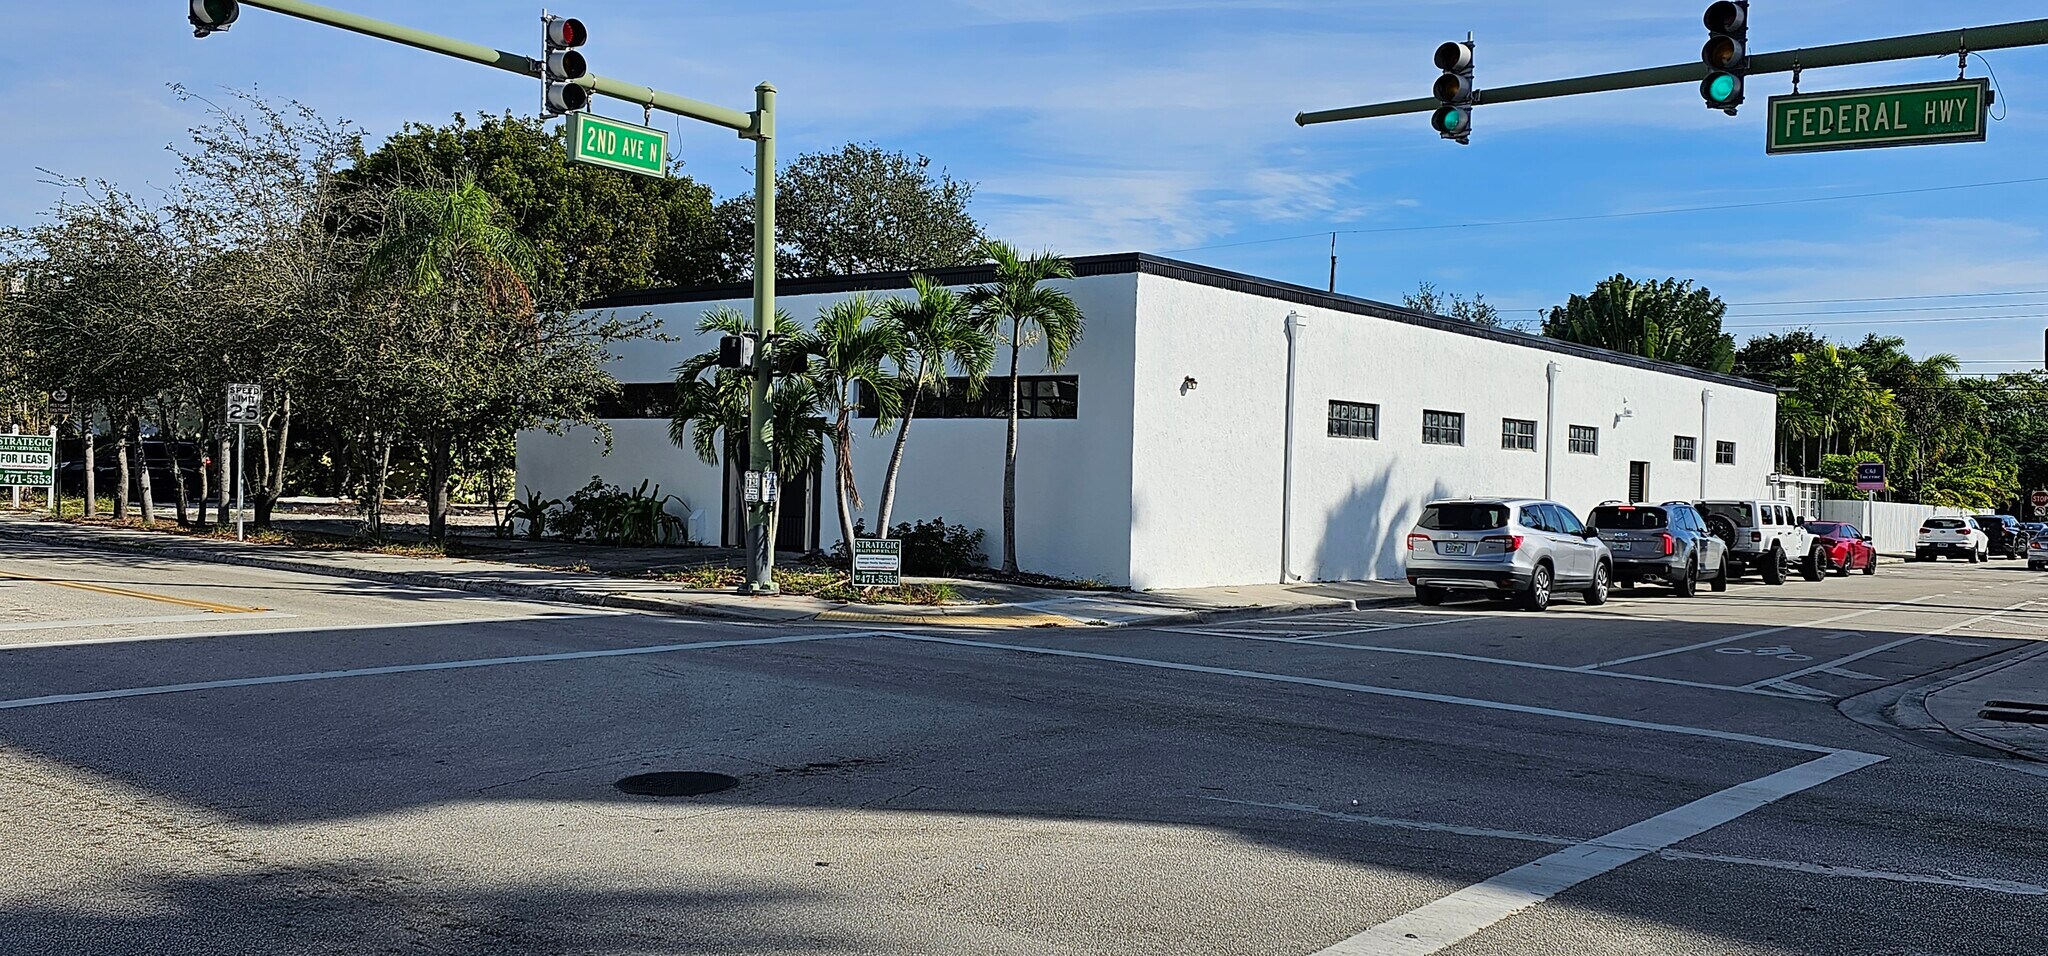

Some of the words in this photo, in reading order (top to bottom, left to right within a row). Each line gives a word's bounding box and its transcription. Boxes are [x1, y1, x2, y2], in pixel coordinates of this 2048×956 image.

[1786, 101, 1907, 137] FEDERAL
[1924, 97, 1968, 125] HWY
[586, 126, 616, 155] 2ND
[622, 136, 644, 160] AVE
[649, 142, 658, 162] N
[229, 386, 259, 395] SPEED
[232, 395, 255, 403] LIMIT
[229, 404, 258, 420] 25
[0, 437, 53, 447] STRATEGIC
[0, 453, 18, 463] FOR
[21, 454, 48, 464] LEASE
[3, 474, 52, 484] 471-5353
[2032, 495, 2048, 503] STOP
[856, 541, 899, 549] STRATEGIC
[861, 575, 898, 583] 471-5353
